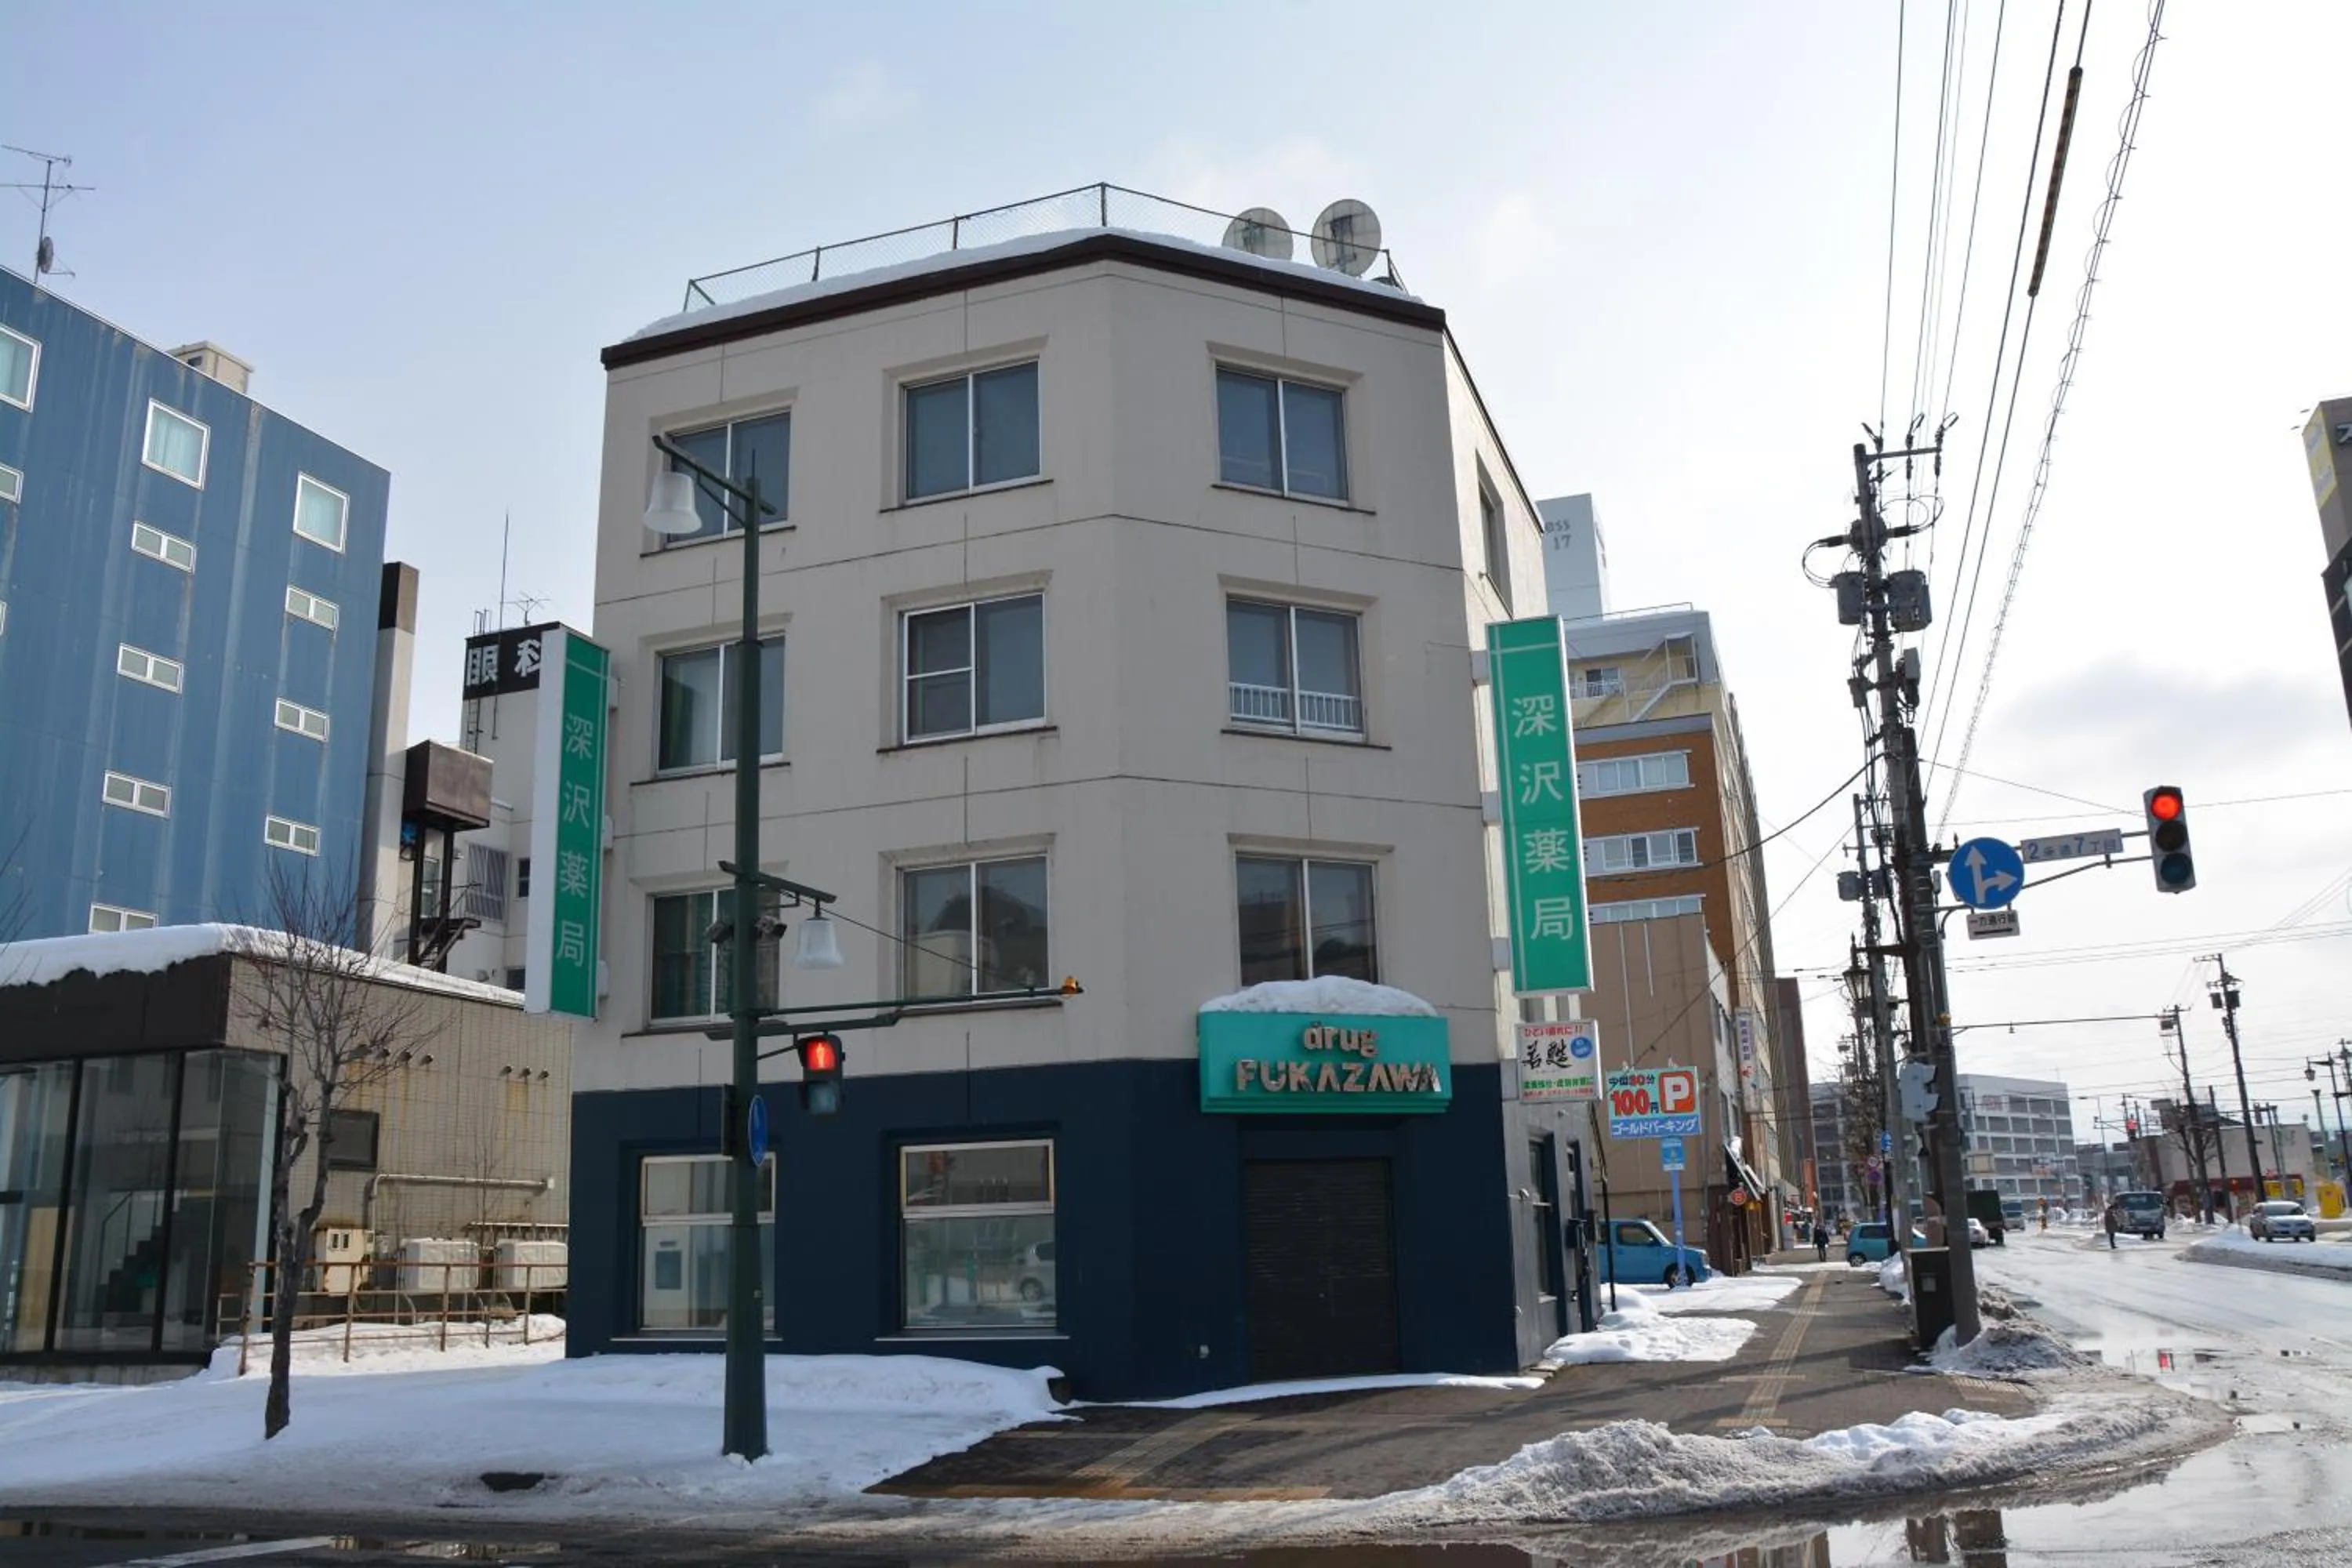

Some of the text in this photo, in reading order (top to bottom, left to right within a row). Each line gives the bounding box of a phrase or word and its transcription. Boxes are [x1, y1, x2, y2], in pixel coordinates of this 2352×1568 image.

[1554, 534, 1572, 550] 17
[1512, 693, 1574, 941] 深沢薬局
[555, 712, 594, 968] 深沢薬局
[1303, 1021, 1380, 1058] drug
[1235, 1059, 1443, 1093] FUKAZAWA
[1610, 1087, 1660, 1116] 100円
[1663, 1076, 1690, 1111] P
[1611, 1116, 1697, 1136] ゴールドパーキング
